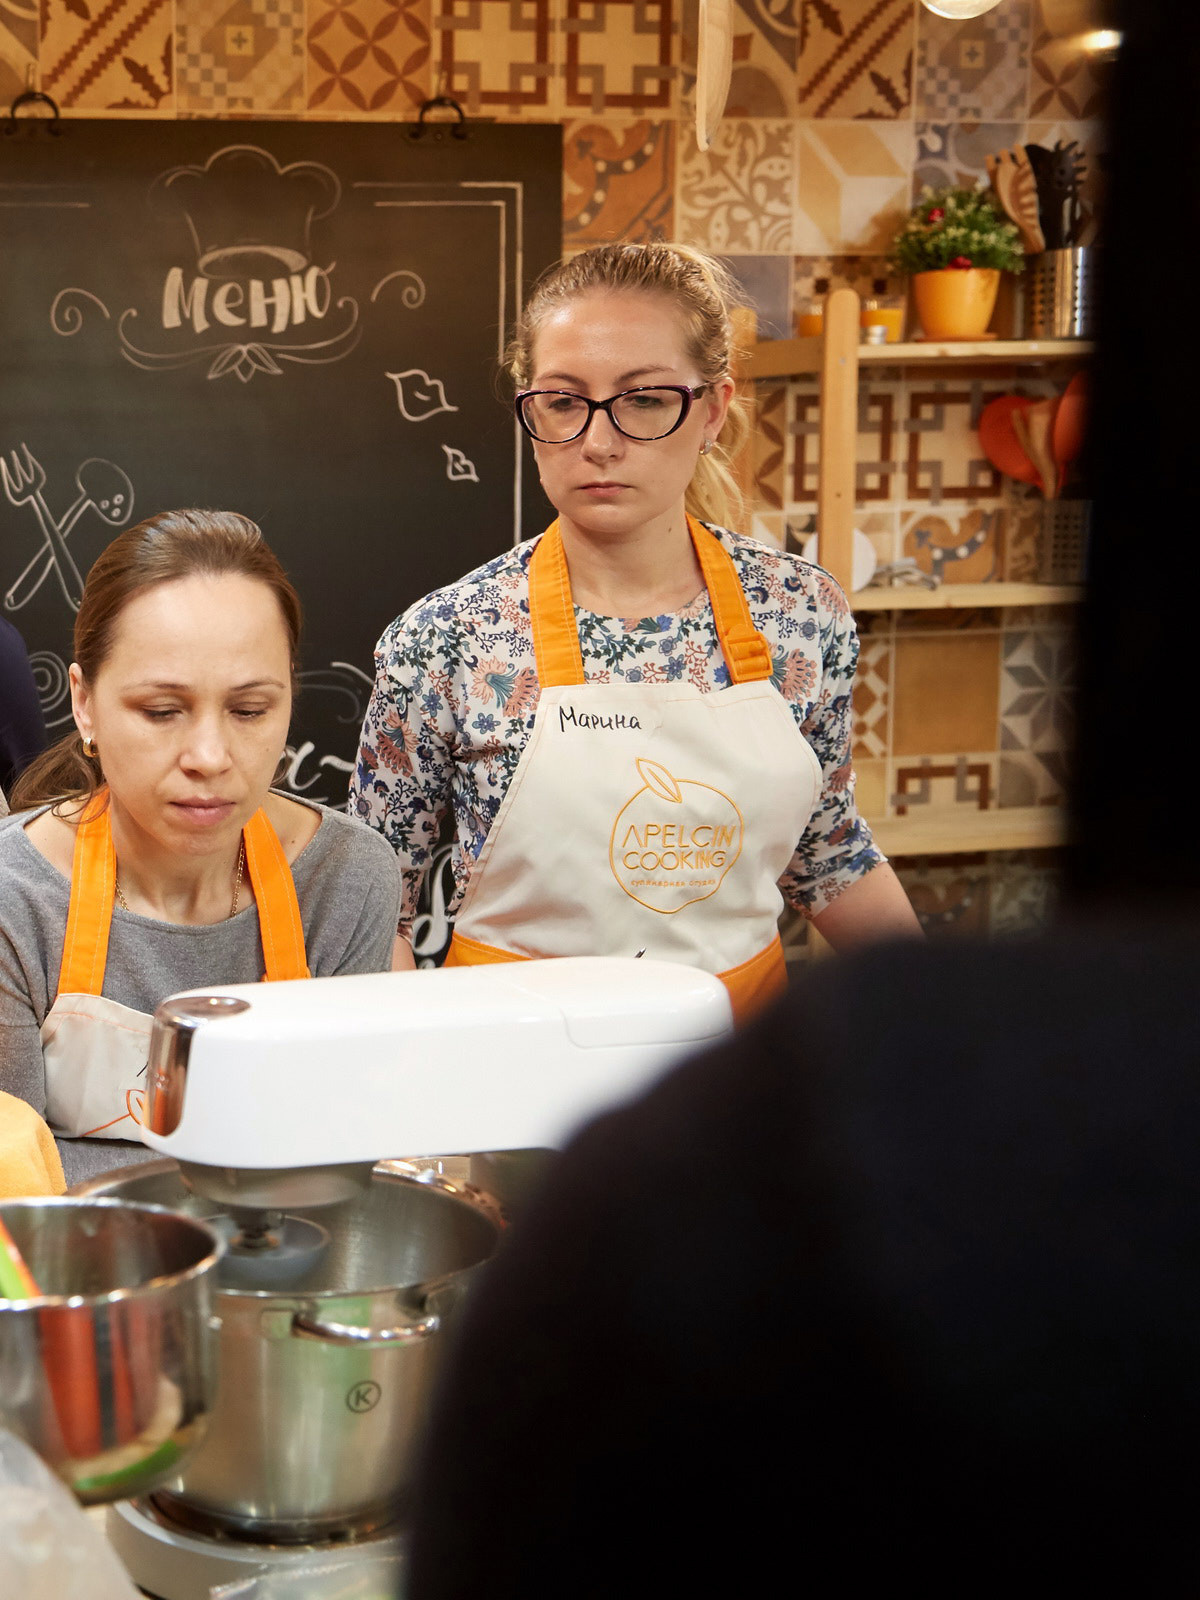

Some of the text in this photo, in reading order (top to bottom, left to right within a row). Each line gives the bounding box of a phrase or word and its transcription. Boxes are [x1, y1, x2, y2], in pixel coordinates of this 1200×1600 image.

[559, 705, 642, 732] Марина
[622, 824, 736, 848] APELCIN
[623, 850, 727, 871] COOKING
